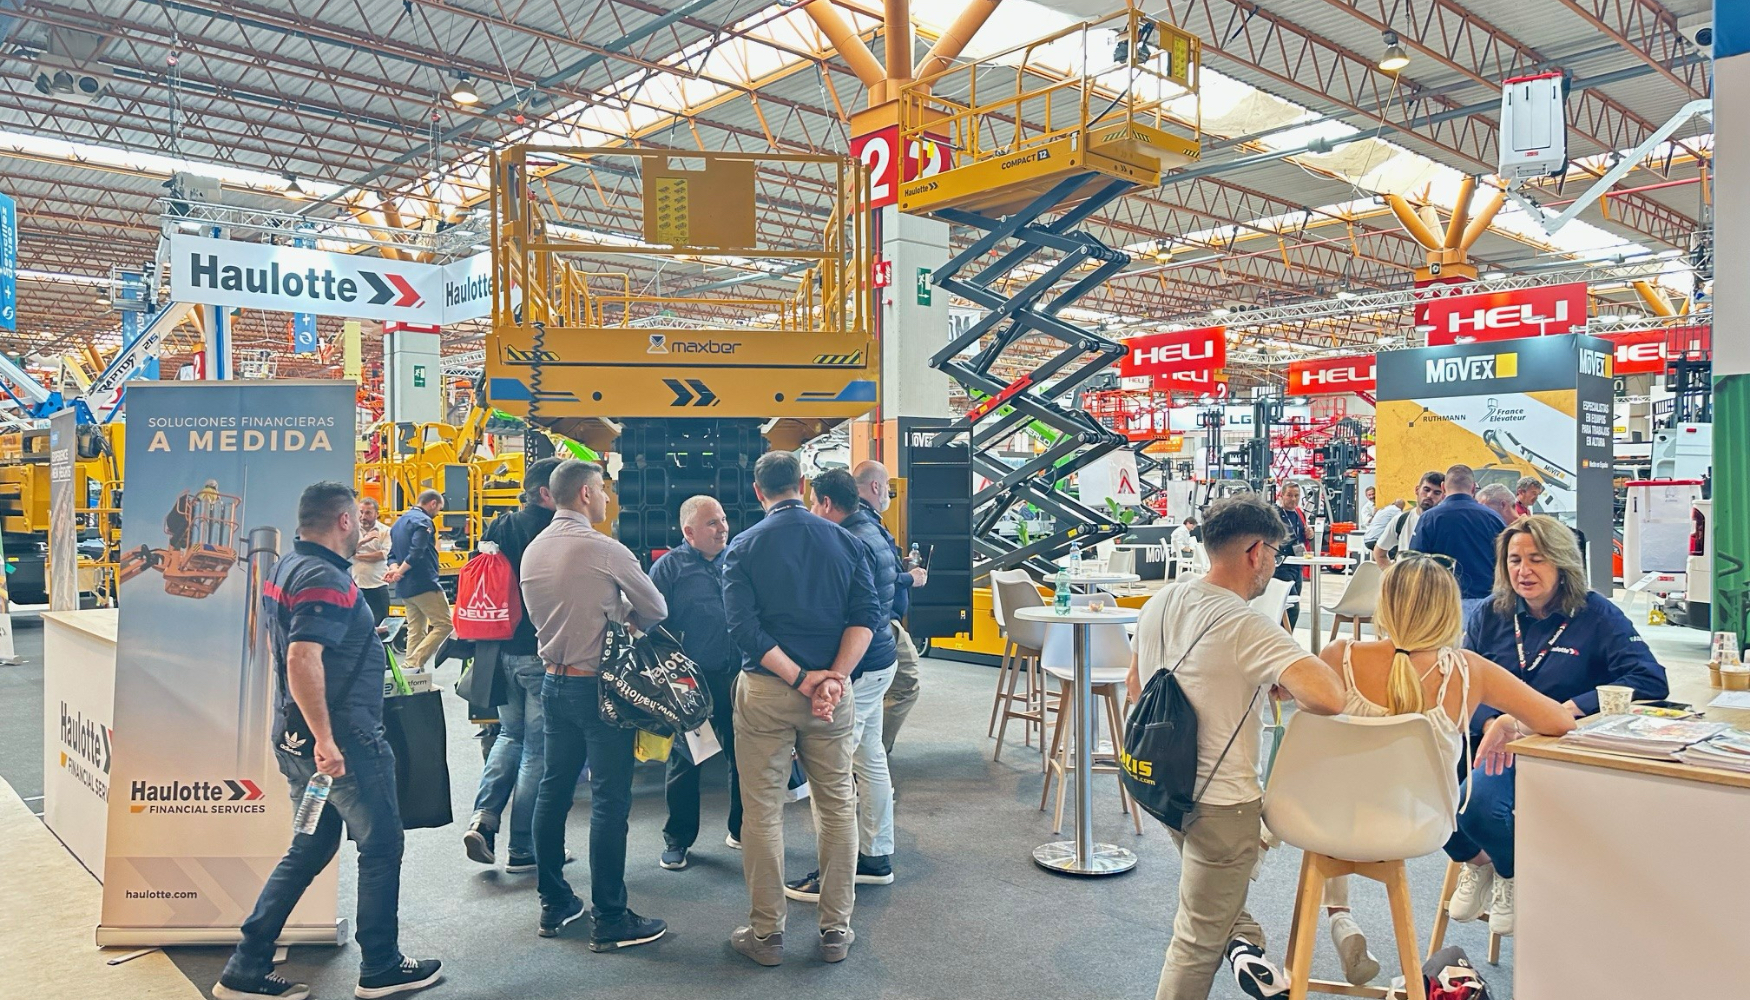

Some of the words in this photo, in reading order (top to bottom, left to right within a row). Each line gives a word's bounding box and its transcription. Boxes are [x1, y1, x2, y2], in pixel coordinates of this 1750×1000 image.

[860, 137, 890, 203] 2
[1001, 154, 1036, 170] COMPACT
[1039, 150, 1047, 159] 12
[904, 184, 929, 197] Haulotte
[191, 252, 358, 303] Haulotte
[446, 273, 493, 307] Haulotte
[1448, 300, 1568, 333] HELI
[671, 340, 742, 354] maxber
[1133, 340, 1214, 366] HELI
[96, 352, 138, 394] RAPTOR
[142, 333, 159, 350] 215
[1302, 364, 1377, 386] HELI
[148, 417, 236, 428] SOLUCIONES
[241, 416, 335, 427] FINANCIERAS
[1423, 414, 1466, 423] RUTHMANN
[1497, 408, 1524, 416] France
[148, 430, 171, 452] A
[189, 429, 333, 452] MEDIDA
[458, 607, 509, 619] DEUTZ
[60, 700, 101, 769] Haulotte
[280, 743, 302, 756] adidas
[68, 757, 94, 792] FINANCIAL
[130, 780, 223, 802] Haulotte
[149, 805, 208, 814] FINANCIAL
[211, 804, 266, 814] SERVICES
[125, 889, 198, 899] haulotte.com
